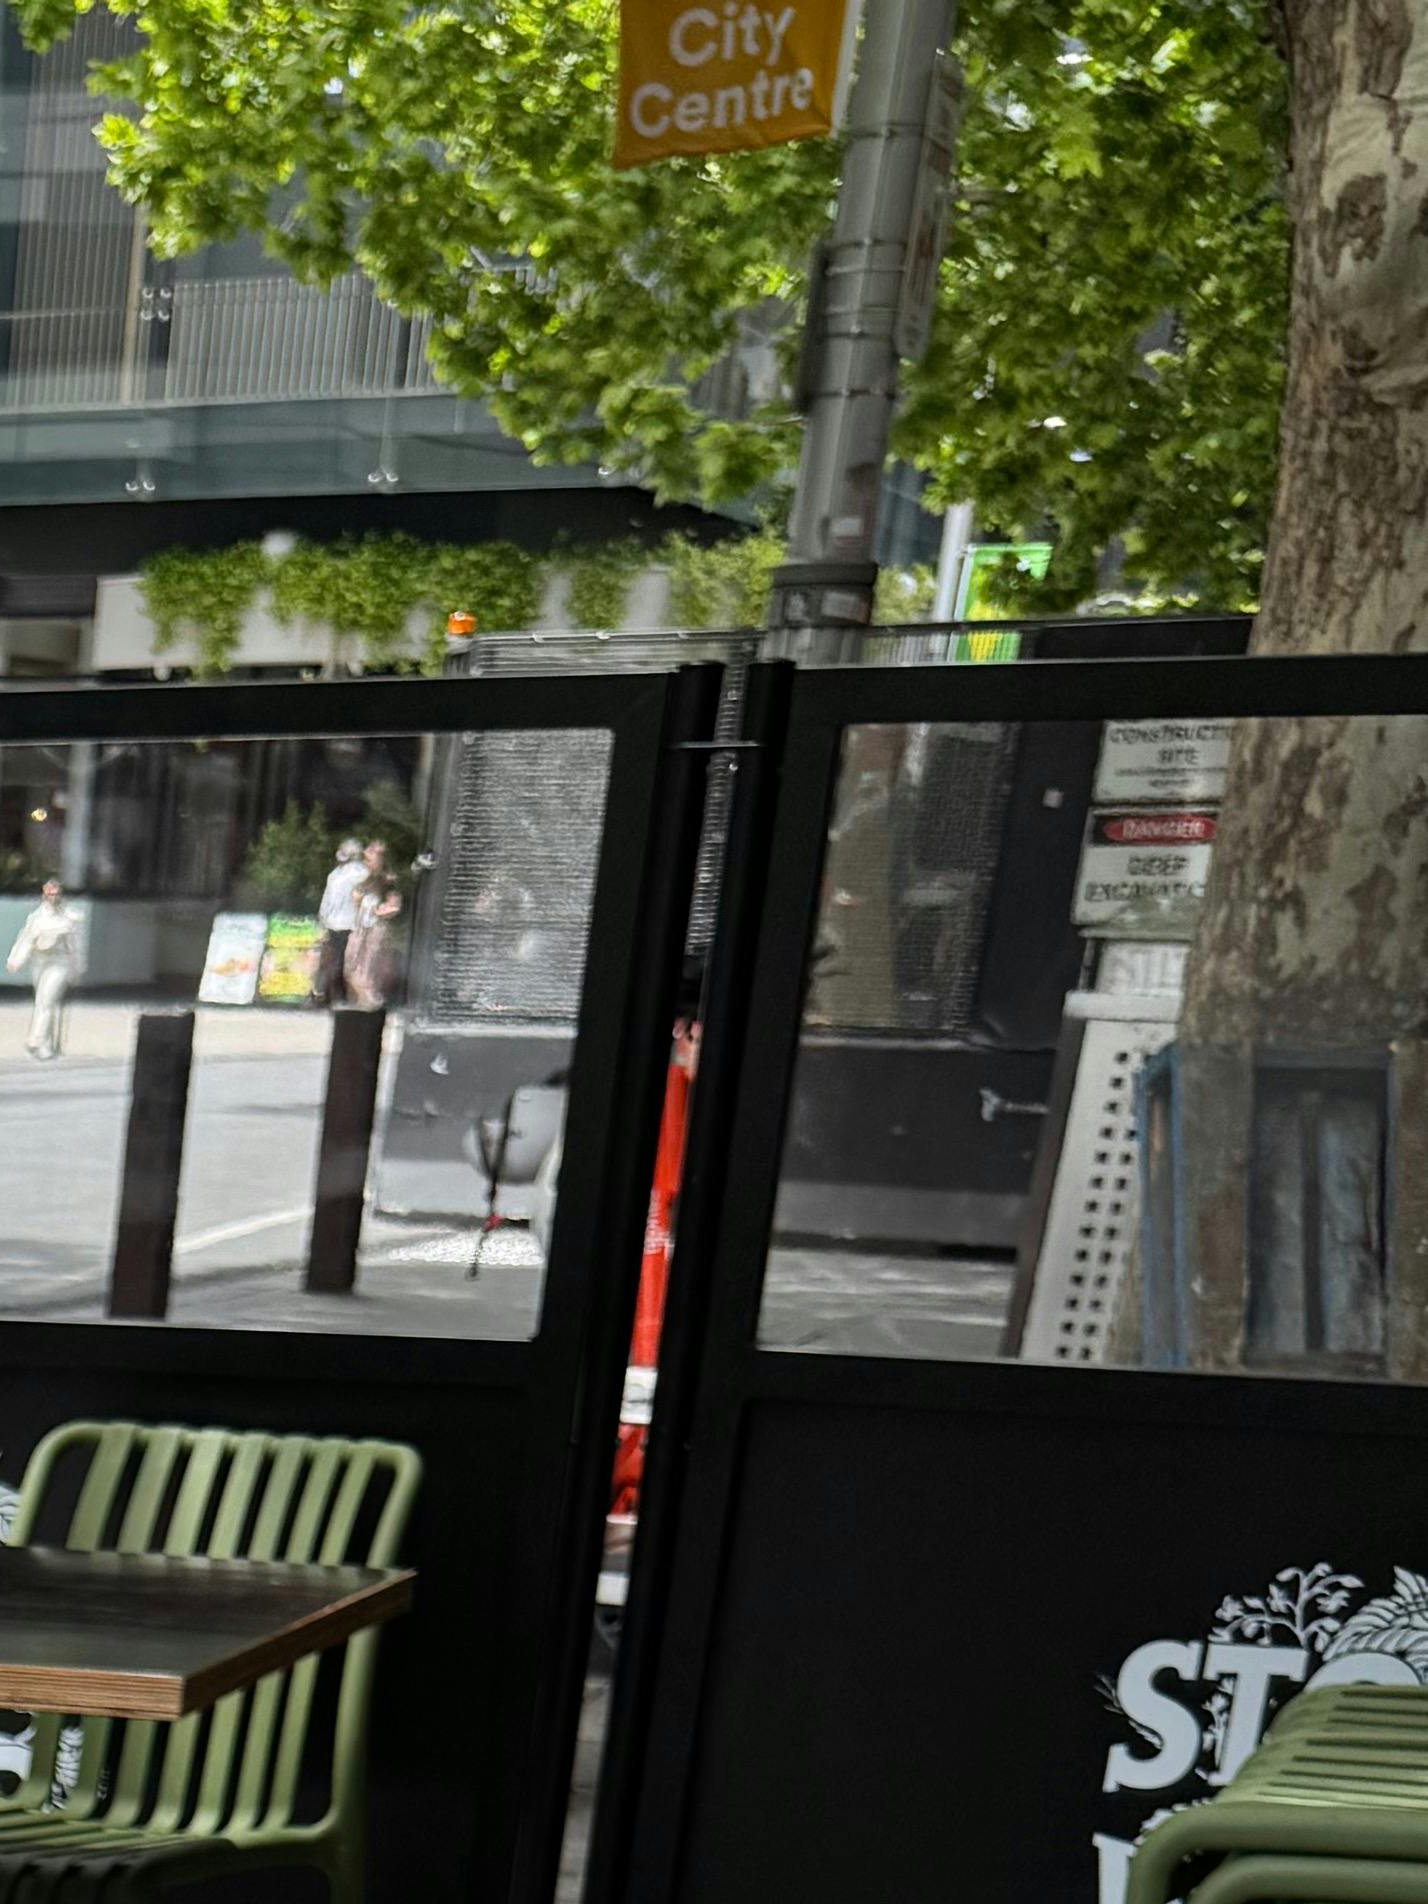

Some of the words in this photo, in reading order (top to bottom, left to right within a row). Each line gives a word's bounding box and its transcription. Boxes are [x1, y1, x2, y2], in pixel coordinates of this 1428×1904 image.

[670, 3, 795, 66] City
[630, 67, 815, 138] Centre
[1122, 819, 1205, 839] DANGER
